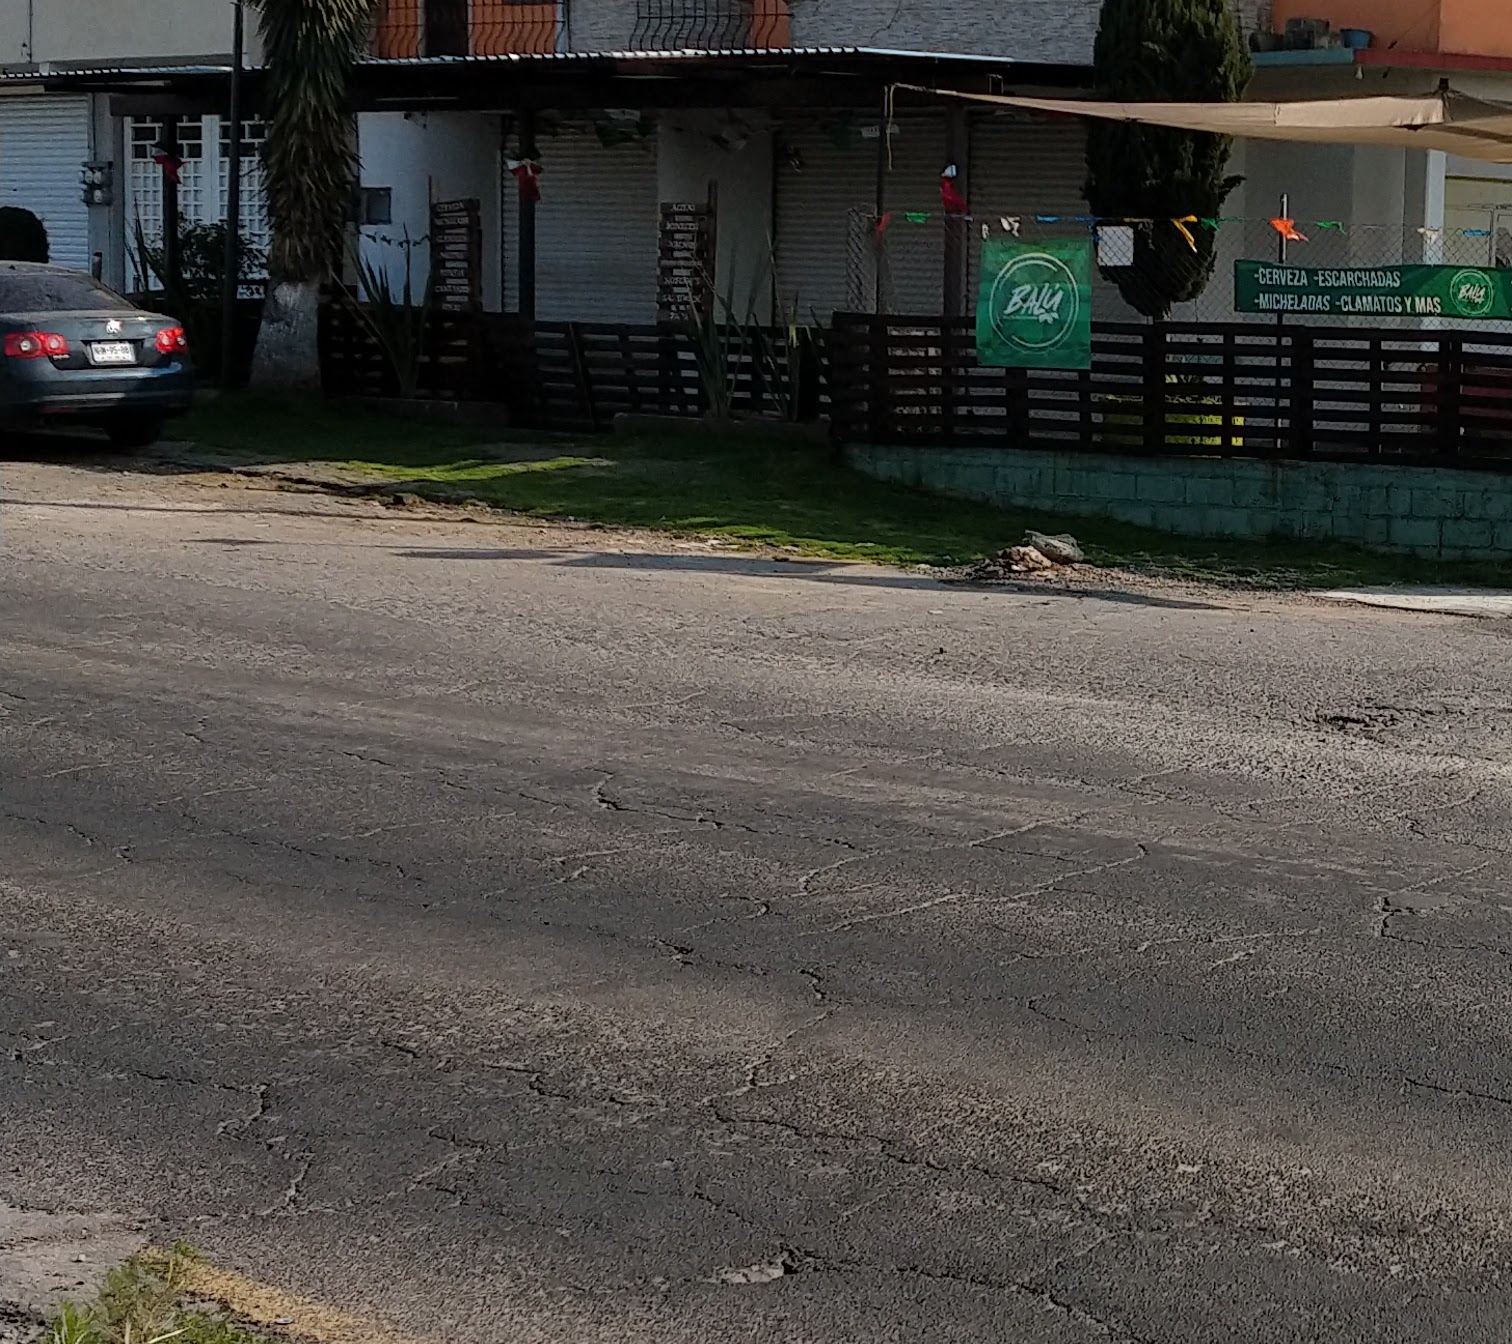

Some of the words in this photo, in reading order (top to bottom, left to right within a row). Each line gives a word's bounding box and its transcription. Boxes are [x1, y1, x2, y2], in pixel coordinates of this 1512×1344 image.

[1254, 267, 1308, 287] -CERVEZA
[1313, 270, 1401, 288] -ESCARCHADAS
[1254, 293, 1331, 312] -MICHELADAS
[1335, 295, 1402, 314] -CLAMATOS
[1403, 297, 1413, 314] Y
